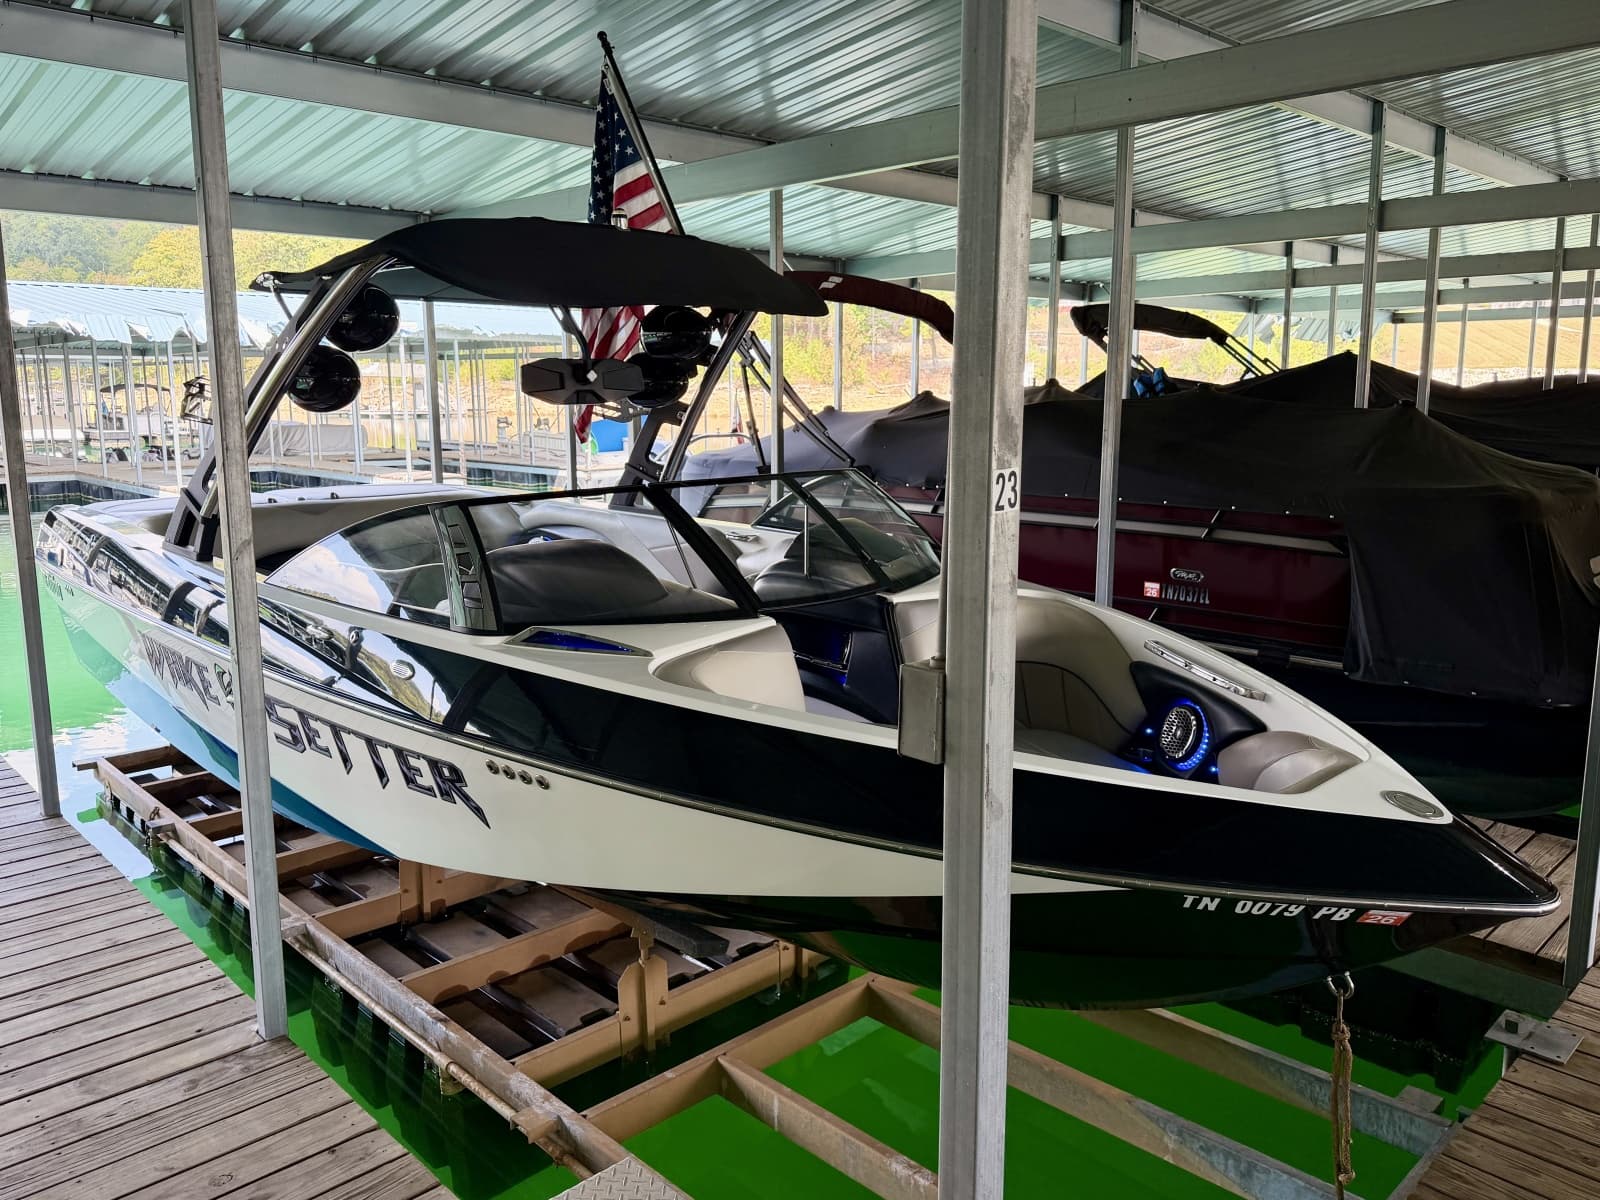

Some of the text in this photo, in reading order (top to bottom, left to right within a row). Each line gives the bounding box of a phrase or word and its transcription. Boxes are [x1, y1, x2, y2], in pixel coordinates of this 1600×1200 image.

[995, 470, 1017, 511] 23
[1146, 588, 1158, 597] 26
[139, 631, 221, 712] WAKE
[264, 694, 491, 830] SETTER
[1183, 894, 1356, 921] TN 0079 PB
[1365, 915, 1398, 925] 26
